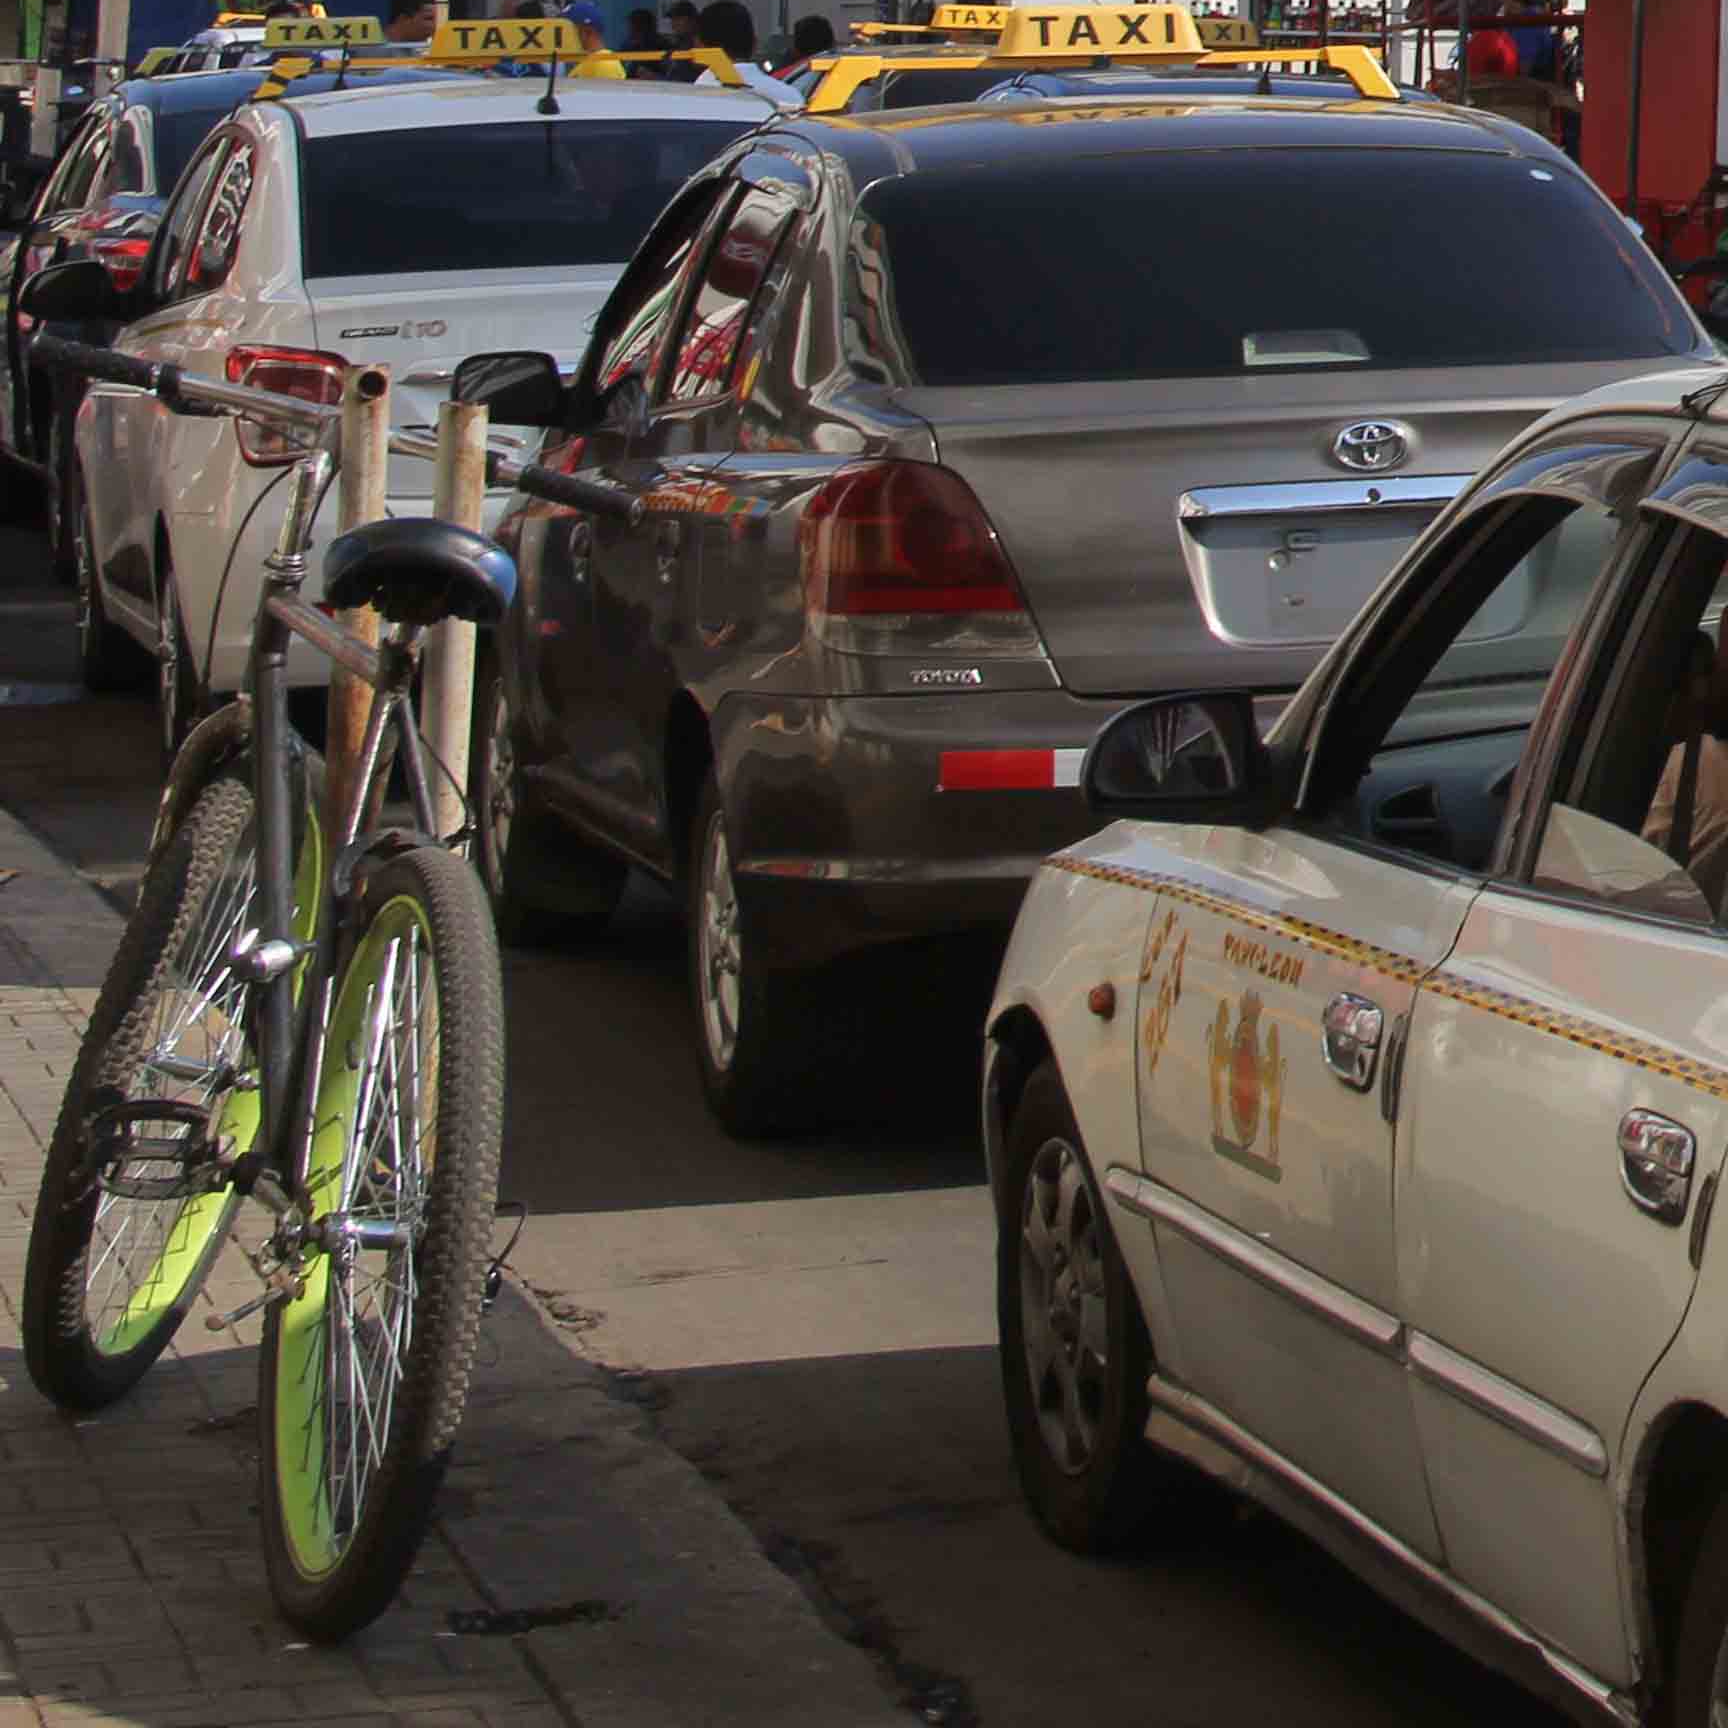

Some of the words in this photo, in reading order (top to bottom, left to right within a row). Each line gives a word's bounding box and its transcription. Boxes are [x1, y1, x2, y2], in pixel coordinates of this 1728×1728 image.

[947, 9, 1001, 26] TAX
[278, 23, 370, 42] TAXI
[453, 25, 563, 51] TAXI
[1029, 12, 1175, 48] TAXI
